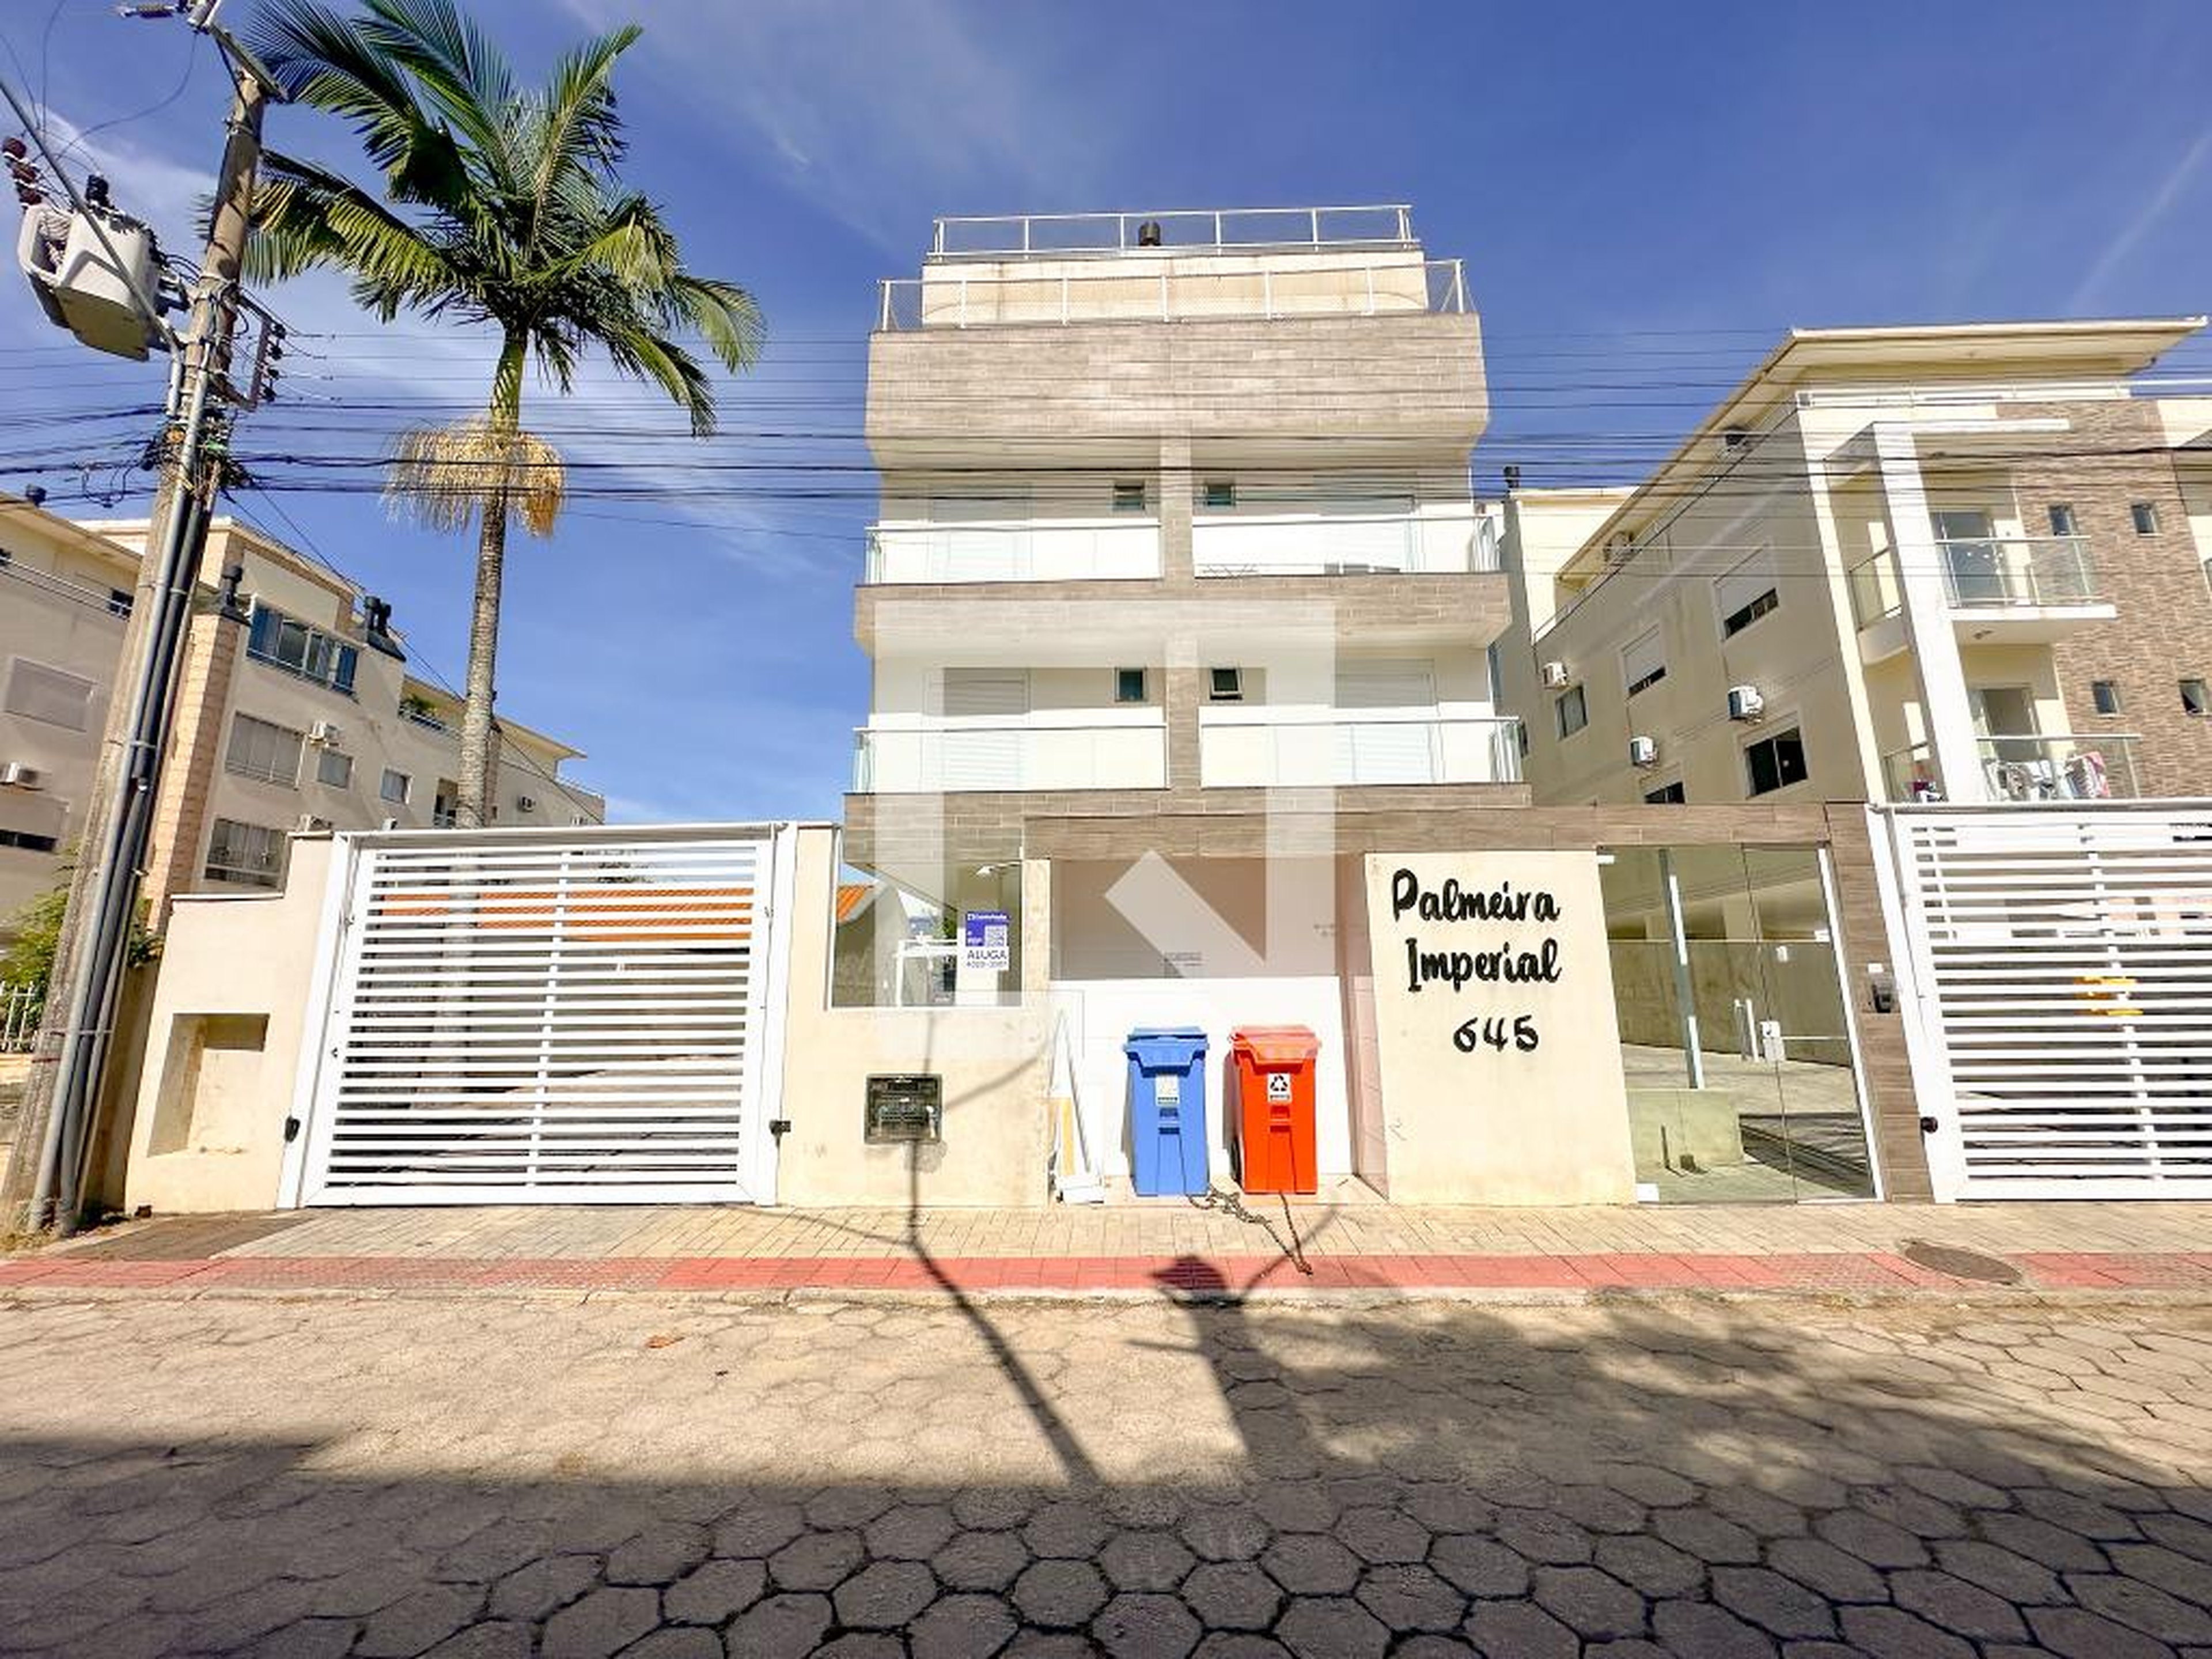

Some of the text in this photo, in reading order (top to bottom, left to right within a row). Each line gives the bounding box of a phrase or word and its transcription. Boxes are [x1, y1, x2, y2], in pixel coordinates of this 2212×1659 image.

[1392, 868, 1561, 922] Palmeira
[967, 950, 1007, 960] ALUGA
[1405, 937, 1562, 993] Imperial
[1453, 1014, 1539, 1053] 645
